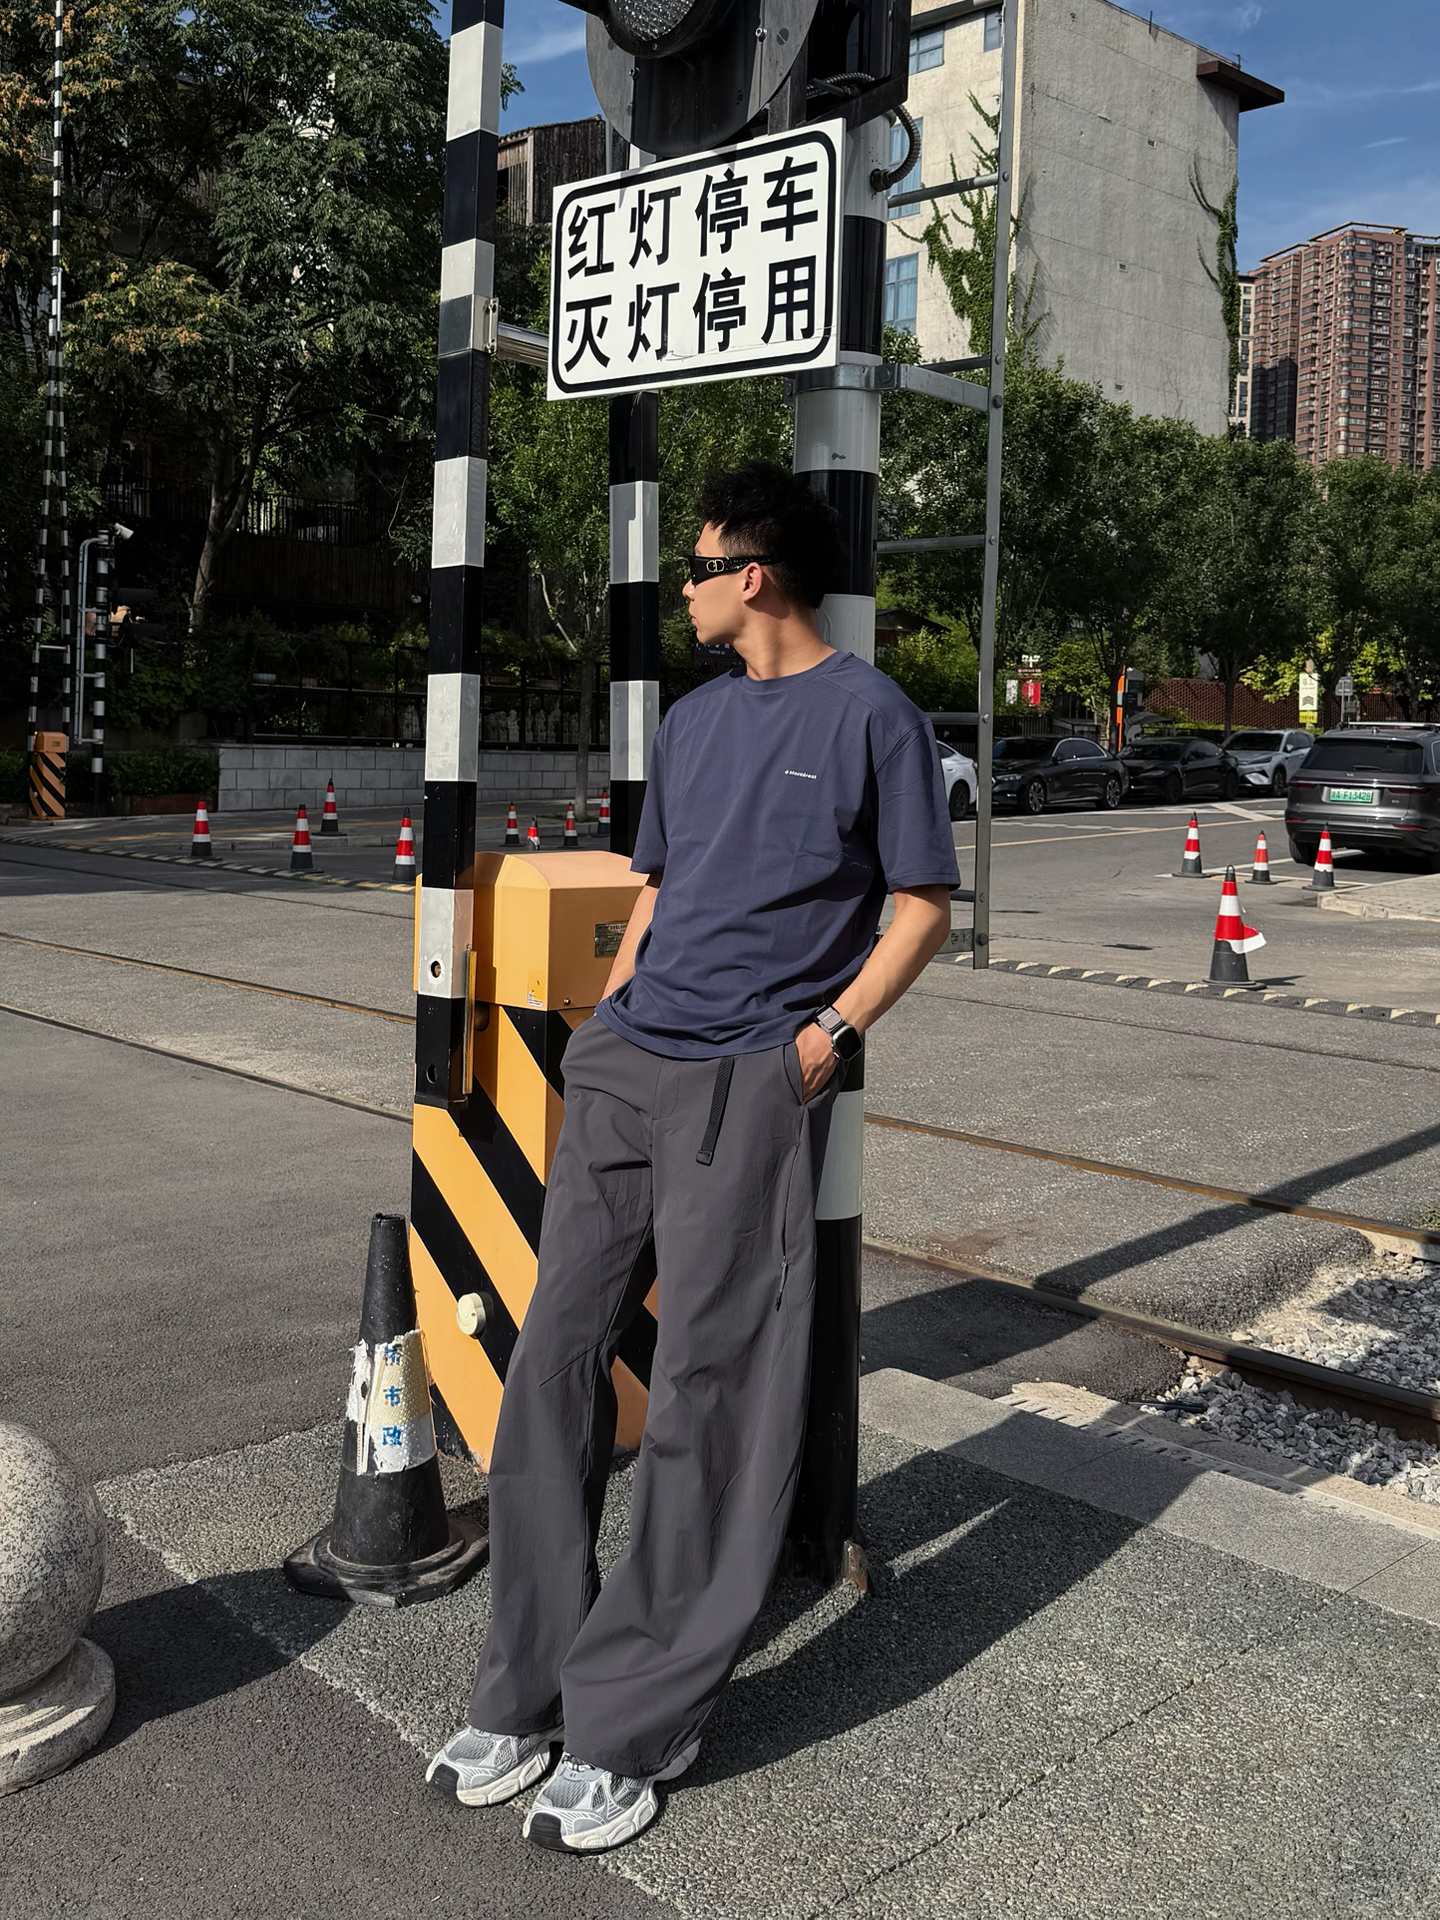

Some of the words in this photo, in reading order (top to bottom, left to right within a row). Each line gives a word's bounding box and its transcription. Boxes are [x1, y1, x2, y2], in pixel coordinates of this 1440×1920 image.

[567, 155, 819, 279] 红灯停车
[564, 255, 817, 373] 灭灯停用
